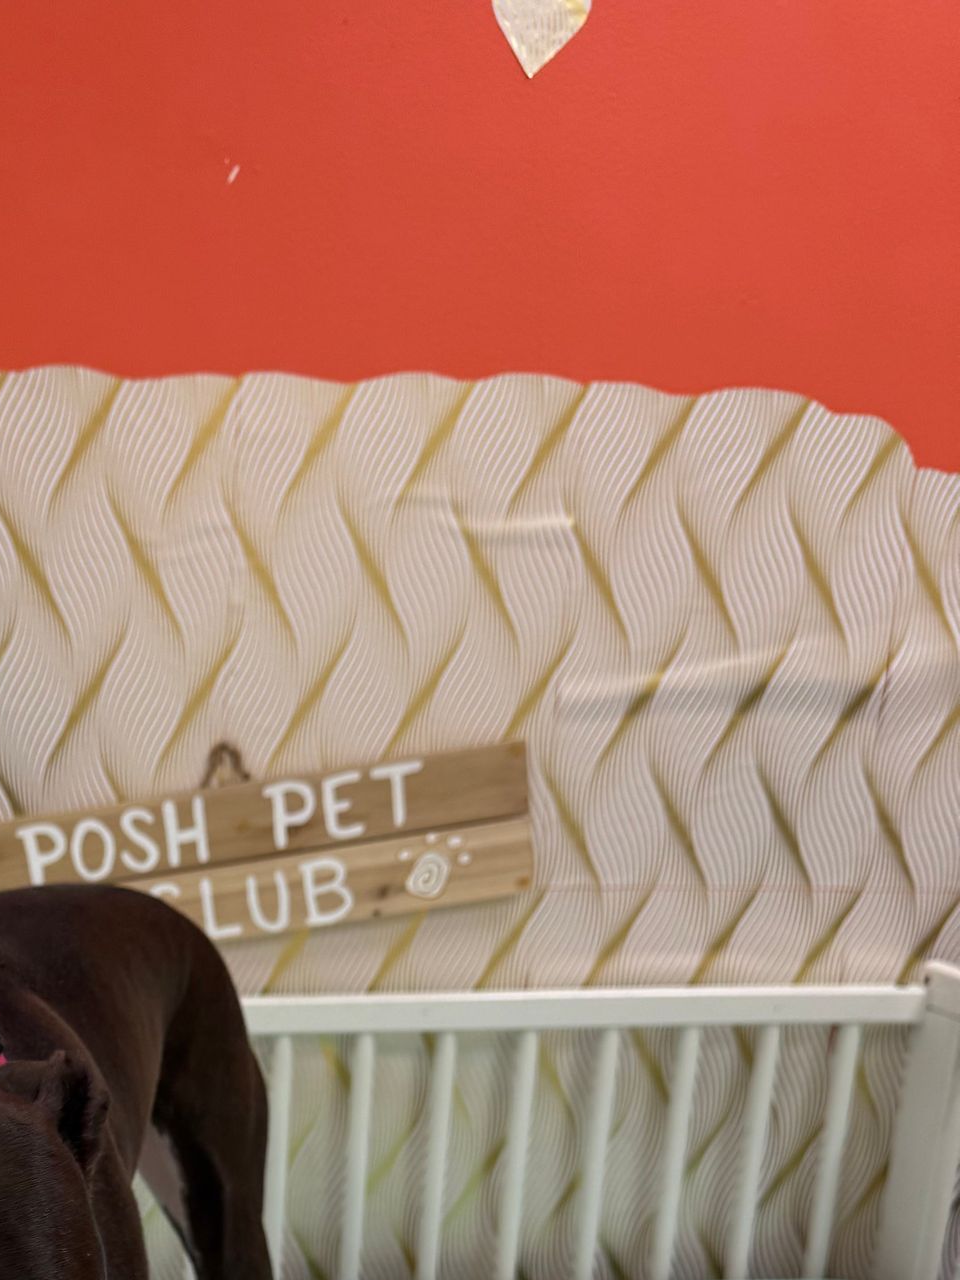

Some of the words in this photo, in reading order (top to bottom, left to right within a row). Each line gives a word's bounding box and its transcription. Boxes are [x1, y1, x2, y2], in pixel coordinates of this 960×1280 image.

[15, 795, 210, 885] POSH
[263, 759, 424, 849] PET
[148, 856, 355, 940] LUB
